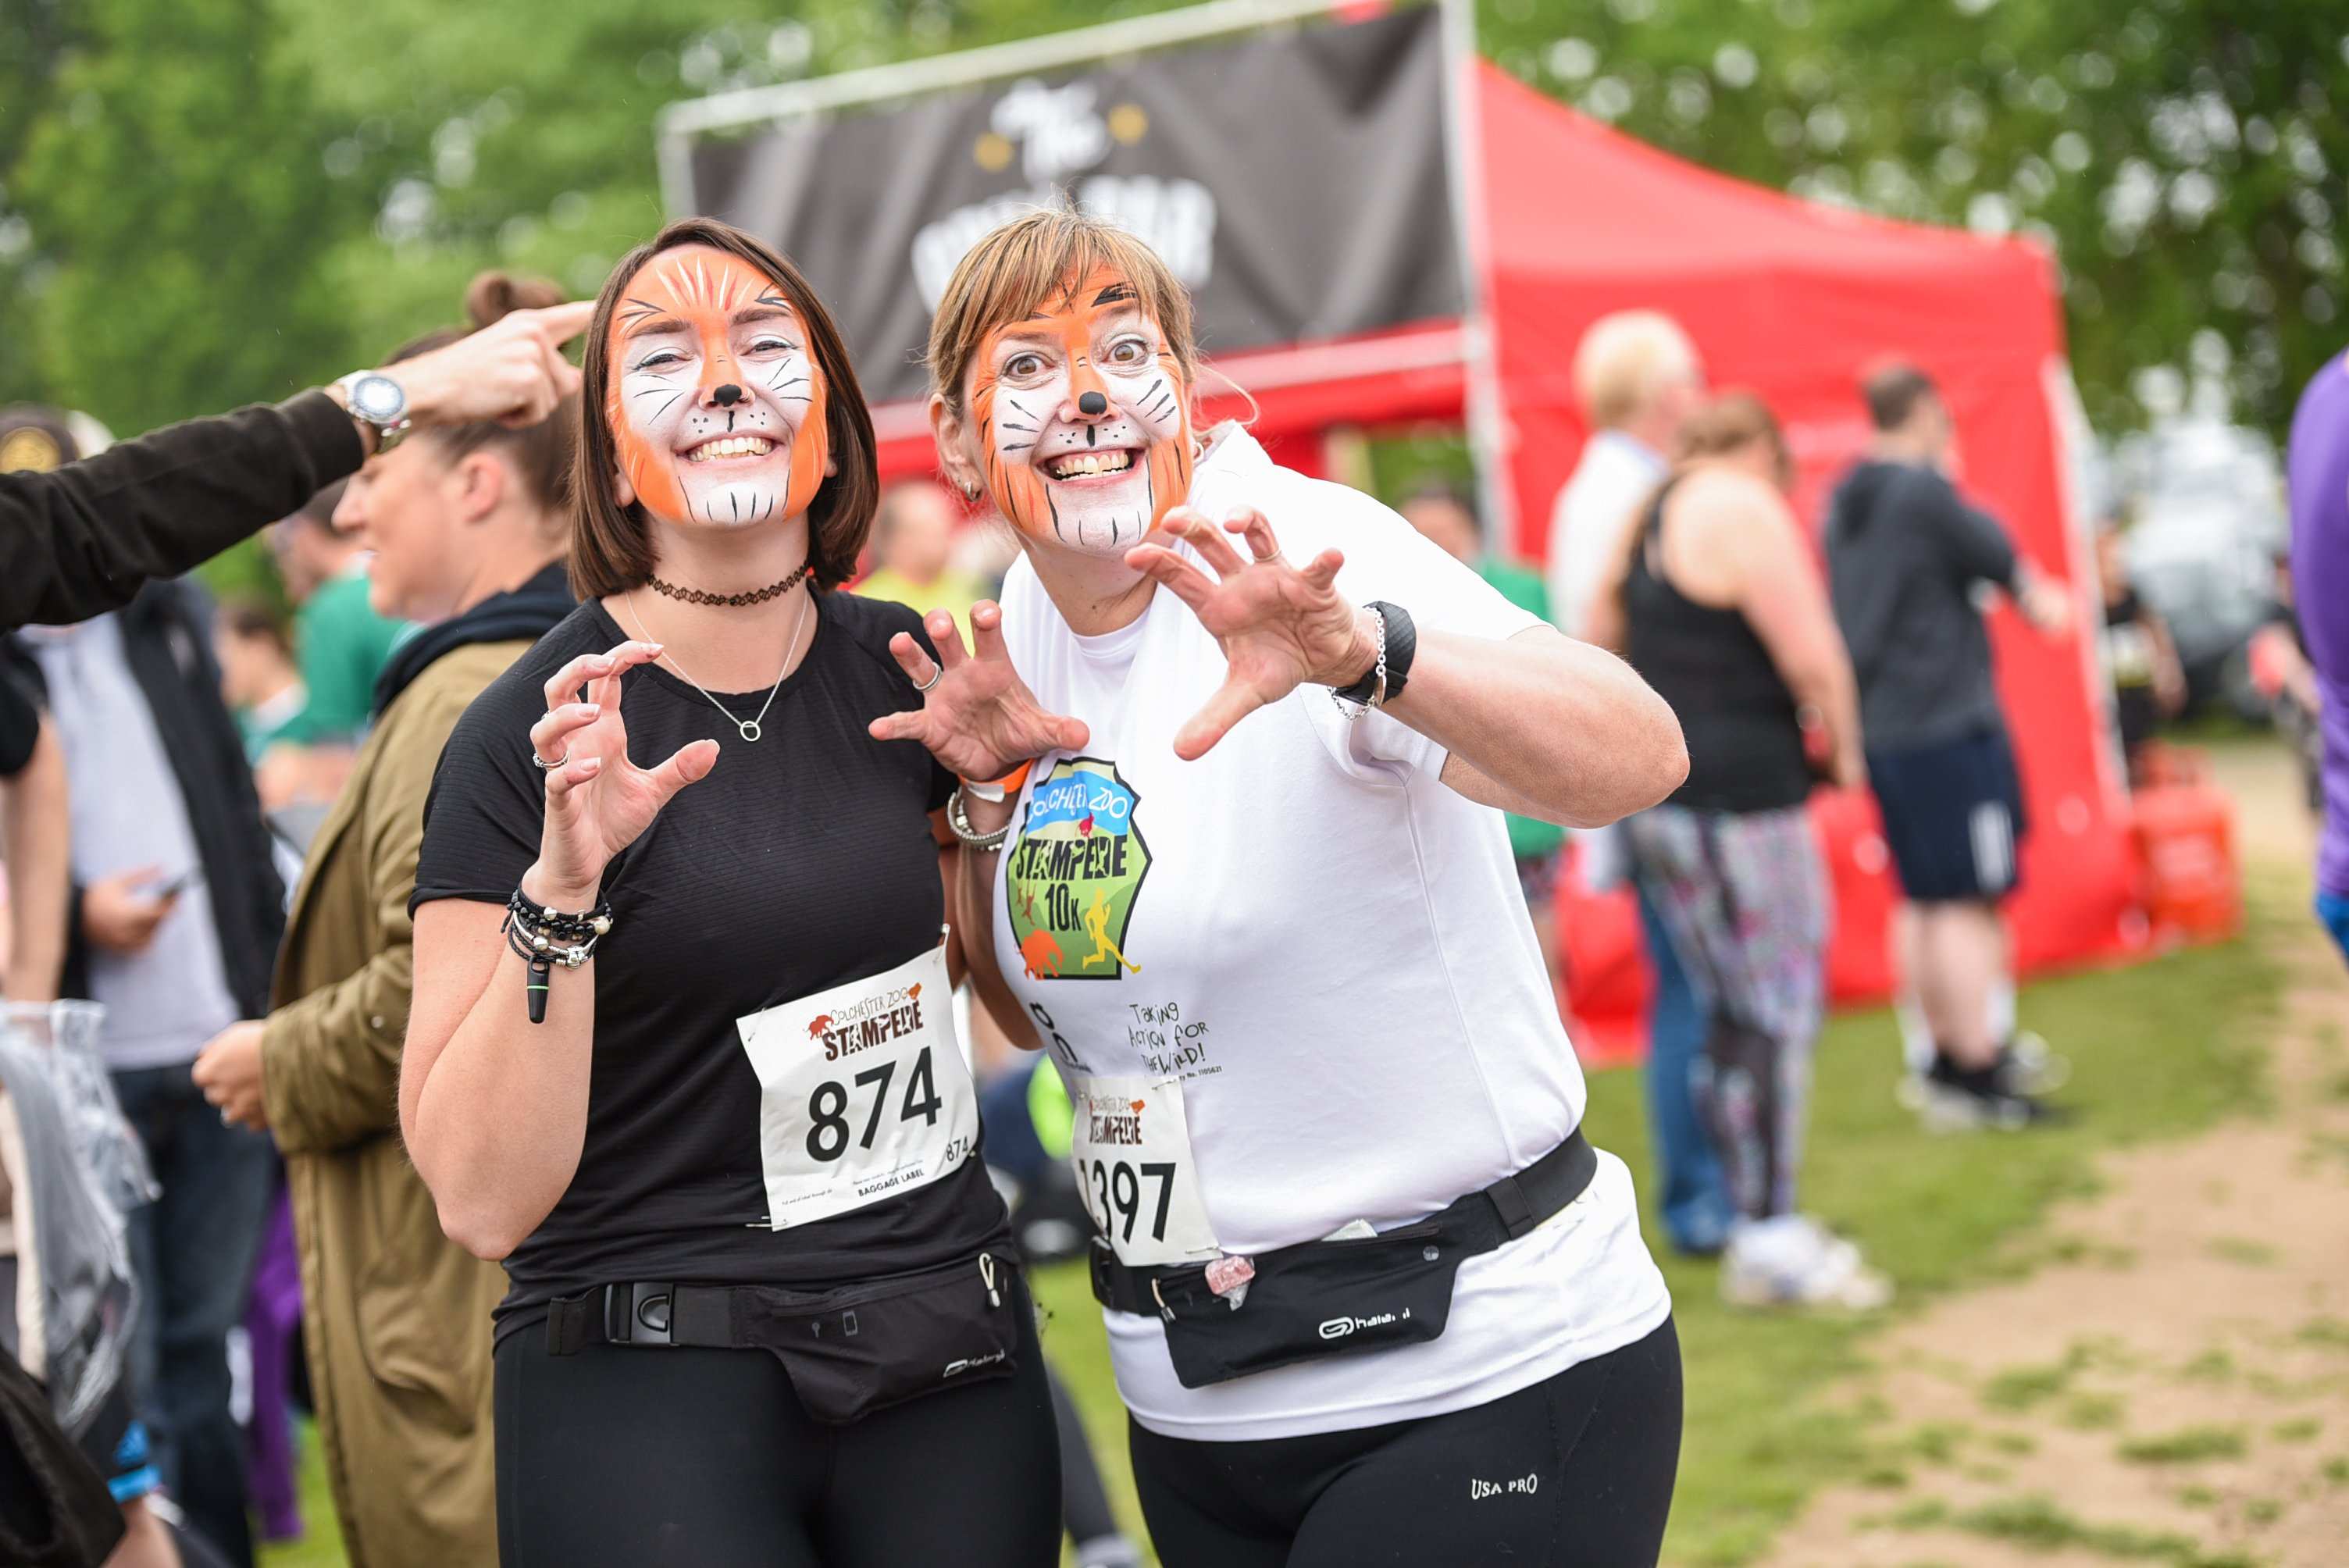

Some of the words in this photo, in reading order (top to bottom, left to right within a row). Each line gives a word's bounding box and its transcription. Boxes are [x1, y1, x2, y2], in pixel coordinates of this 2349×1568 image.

[1016, 836, 1127, 881] STAMPEDE
[1045, 883, 1082, 932] 10K
[831, 996, 886, 1025] COLCHESTER
[887, 986, 908, 1008] ZOO
[822, 1000, 924, 1062] STAMPEDE
[806, 1046, 943, 1163] 874
[857, 1177, 900, 1197] BAGGAGE
[900, 1168, 925, 1182] LABEL
[1471, 1478, 1502, 1500] USA
[1508, 1473, 1538, 1494] PRO
